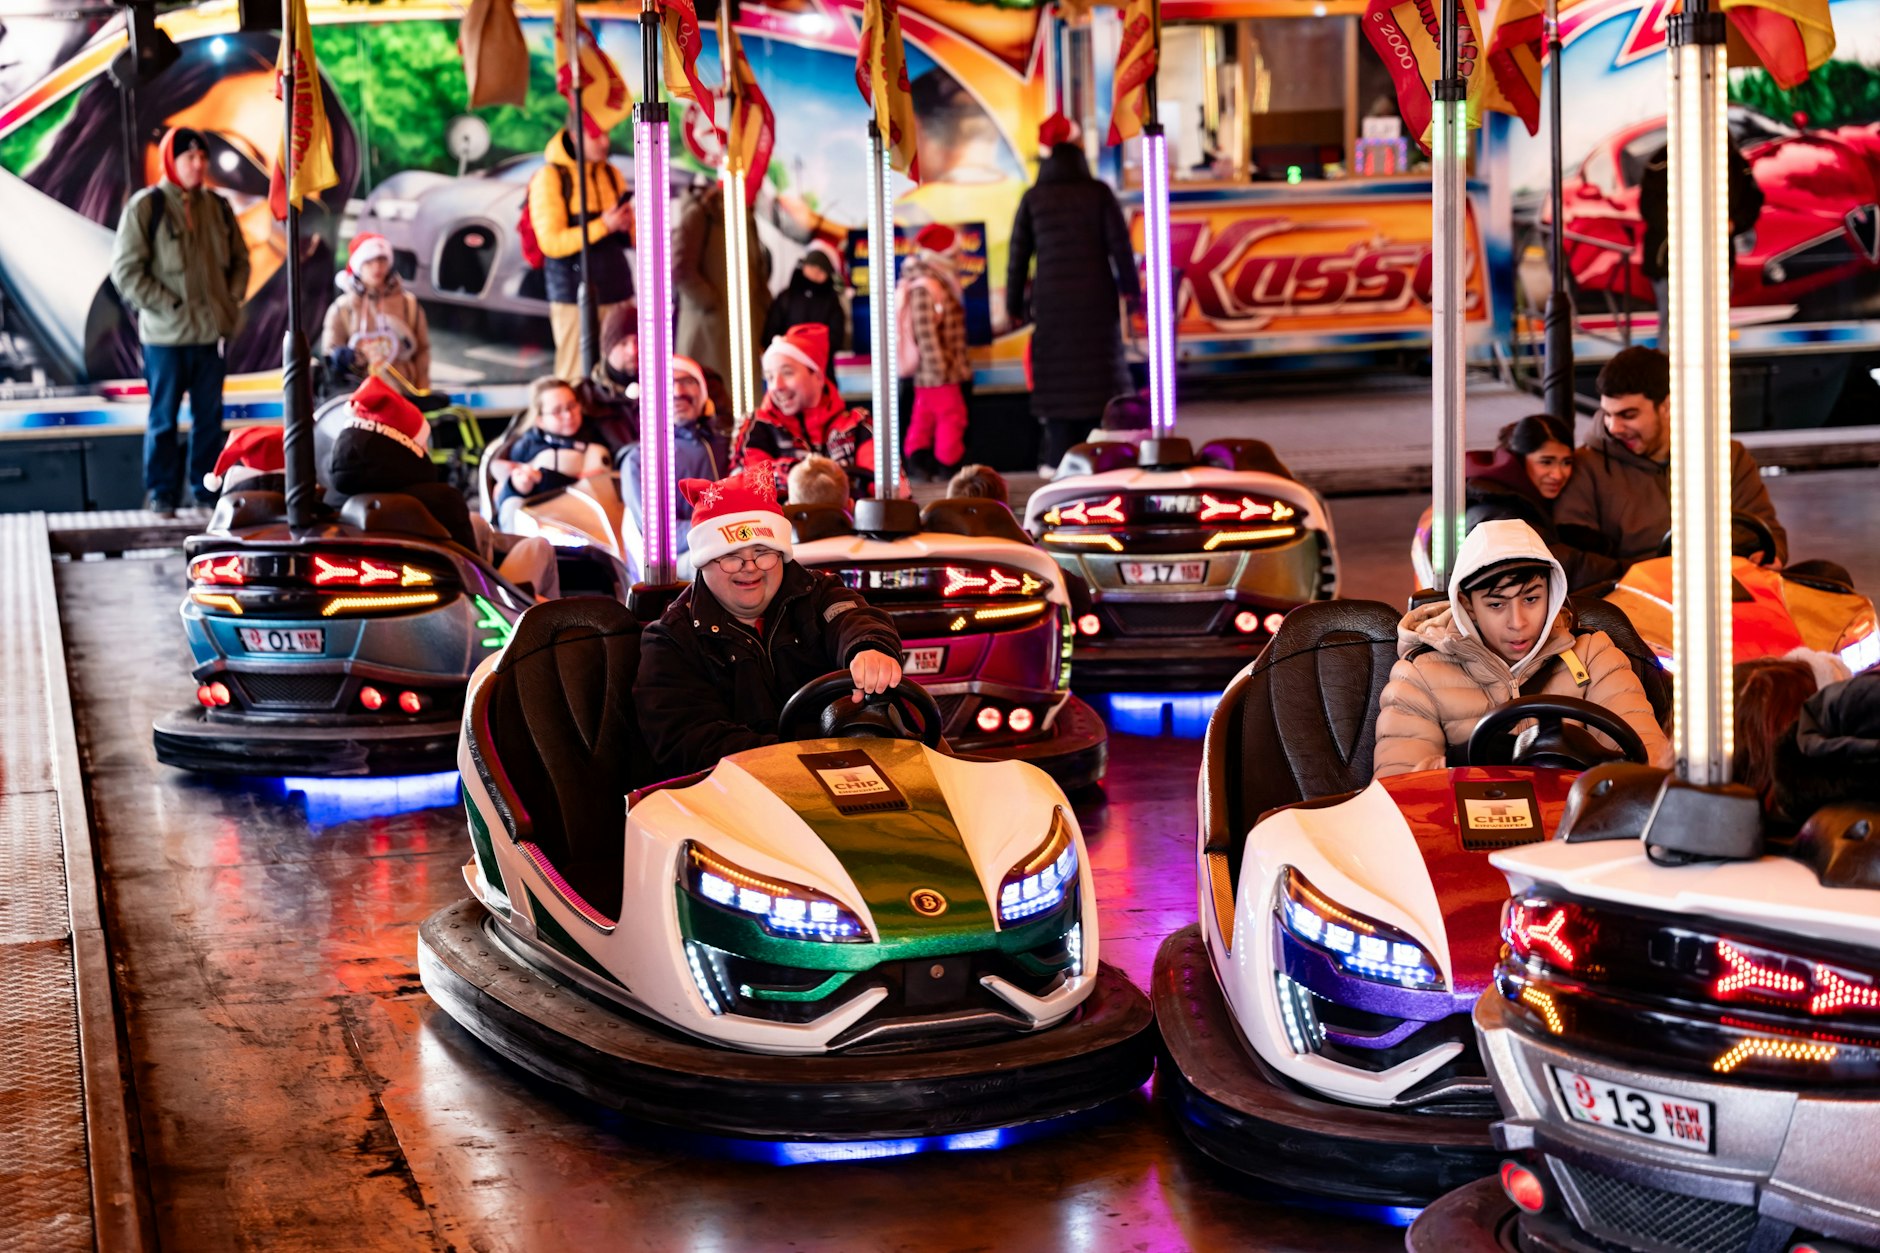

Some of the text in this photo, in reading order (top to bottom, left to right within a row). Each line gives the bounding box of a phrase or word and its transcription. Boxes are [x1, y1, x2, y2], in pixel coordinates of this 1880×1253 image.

[1380, 24, 1413, 70] 2000
[1152, 564, 1175, 582] 17
[268, 630, 297, 651] 01
[915, 651, 938, 660] NEW
[834, 780, 879, 790] CHIP
[1474, 815, 1526, 823] CHIP
[1606, 1088, 1656, 1134] 13
[1662, 1102, 1699, 1123] NEW
[1666, 1119, 1706, 1143] YORK
